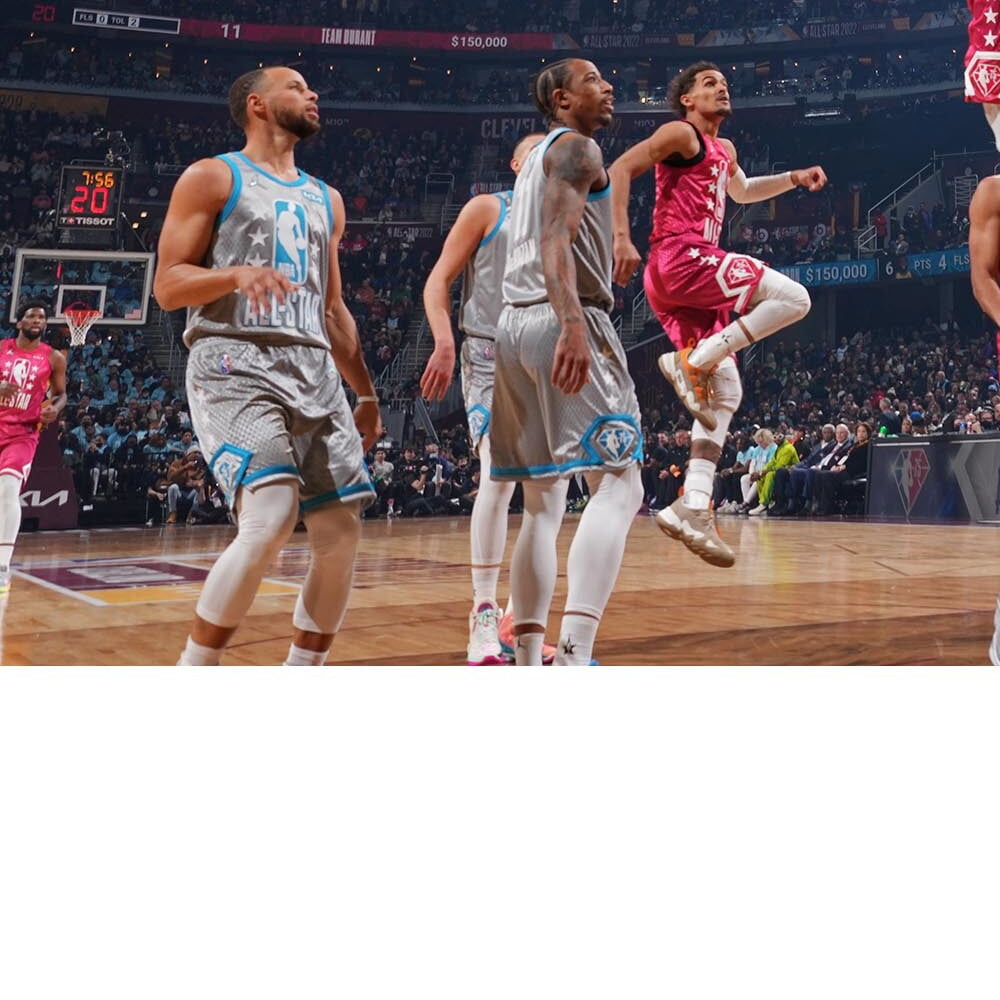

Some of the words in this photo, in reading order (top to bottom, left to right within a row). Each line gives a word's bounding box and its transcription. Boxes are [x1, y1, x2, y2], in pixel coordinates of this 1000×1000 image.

[221, 23, 241, 39] 11
[321, 28, 342, 44] TEAM
[343, 29, 376, 46] DURANT
[451, 35, 508, 48] $150,000
[82, 171, 114, 189] 7:56
[71, 186, 109, 214] 20
[75, 217, 115, 226] TISSOT
[806, 263, 867, 284] $150,000
[886, 261, 894, 276] 6
[914, 259, 931, 271] PTS
[938, 254, 947, 271] 4
